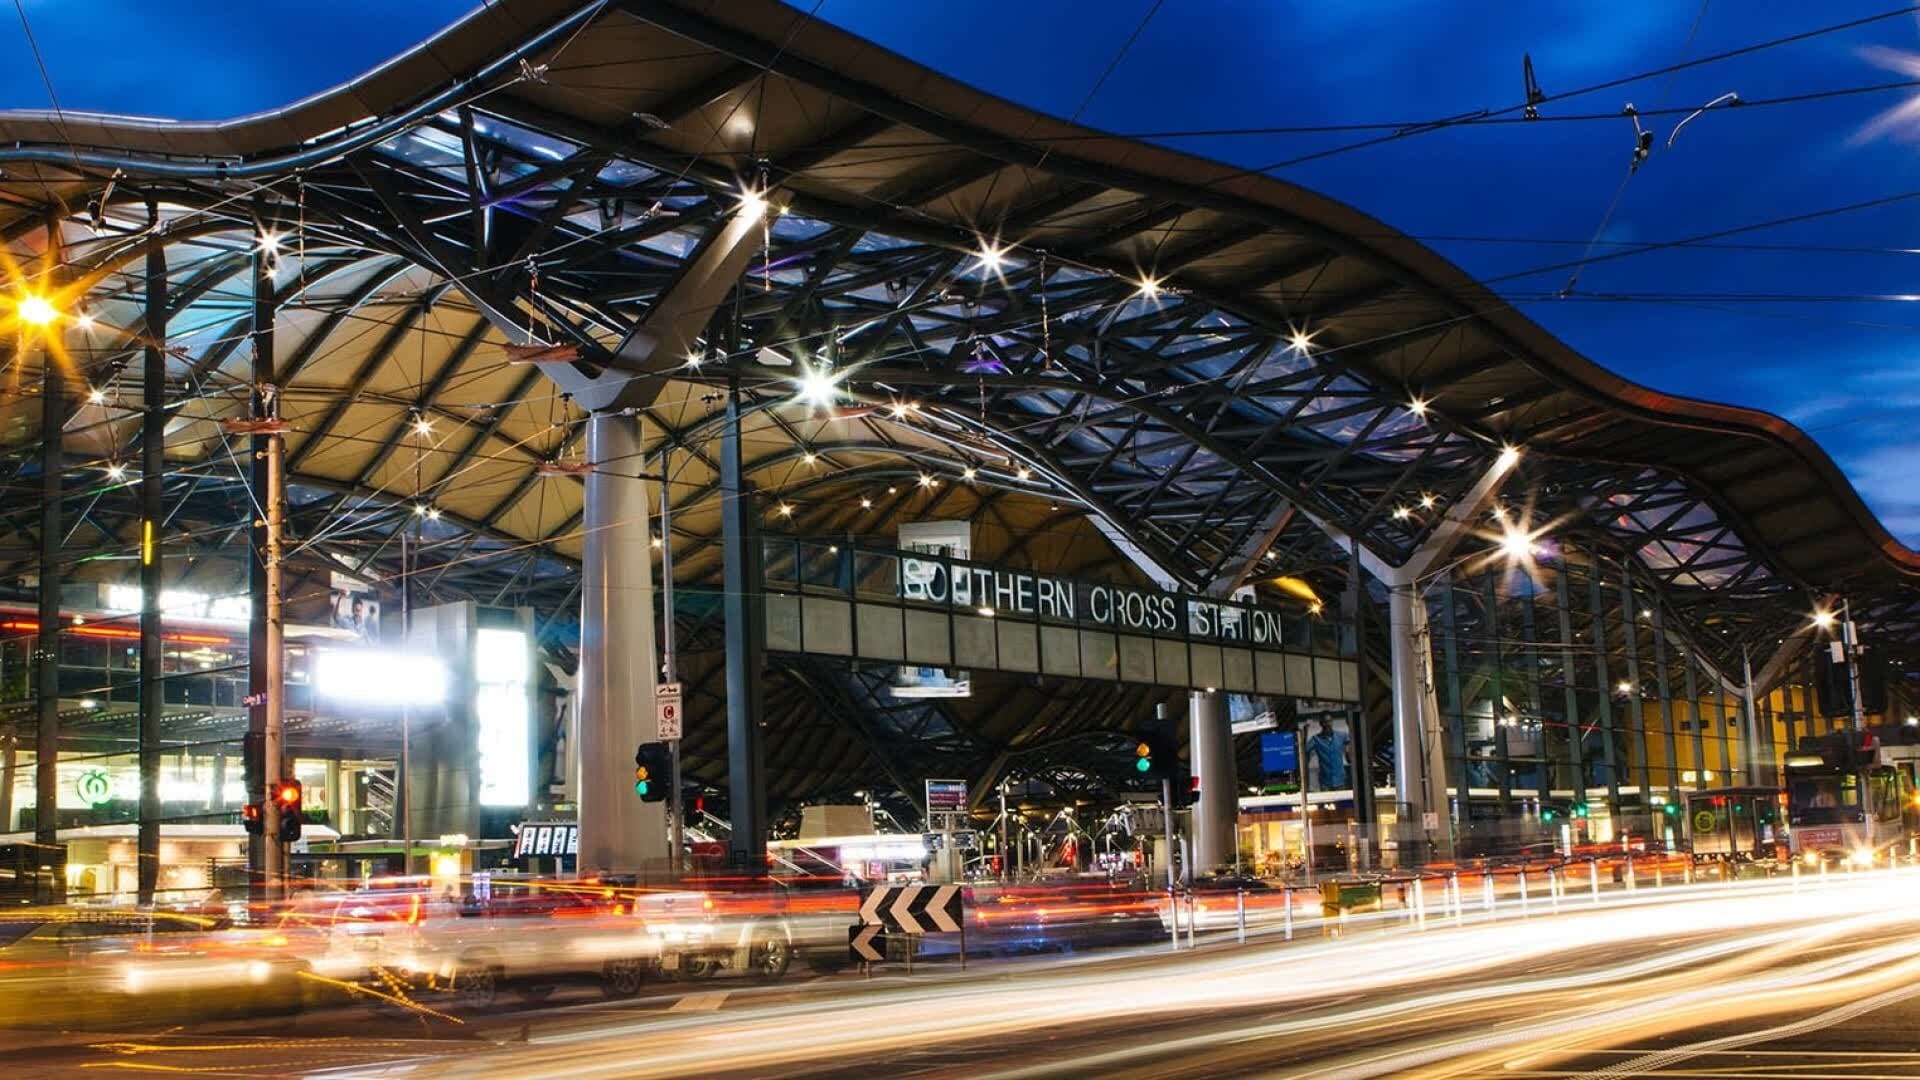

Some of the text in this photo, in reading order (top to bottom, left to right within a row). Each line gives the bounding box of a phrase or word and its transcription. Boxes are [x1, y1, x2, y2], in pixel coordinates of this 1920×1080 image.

[904, 558, 1282, 644] SOUTHERN CROSS STATION
